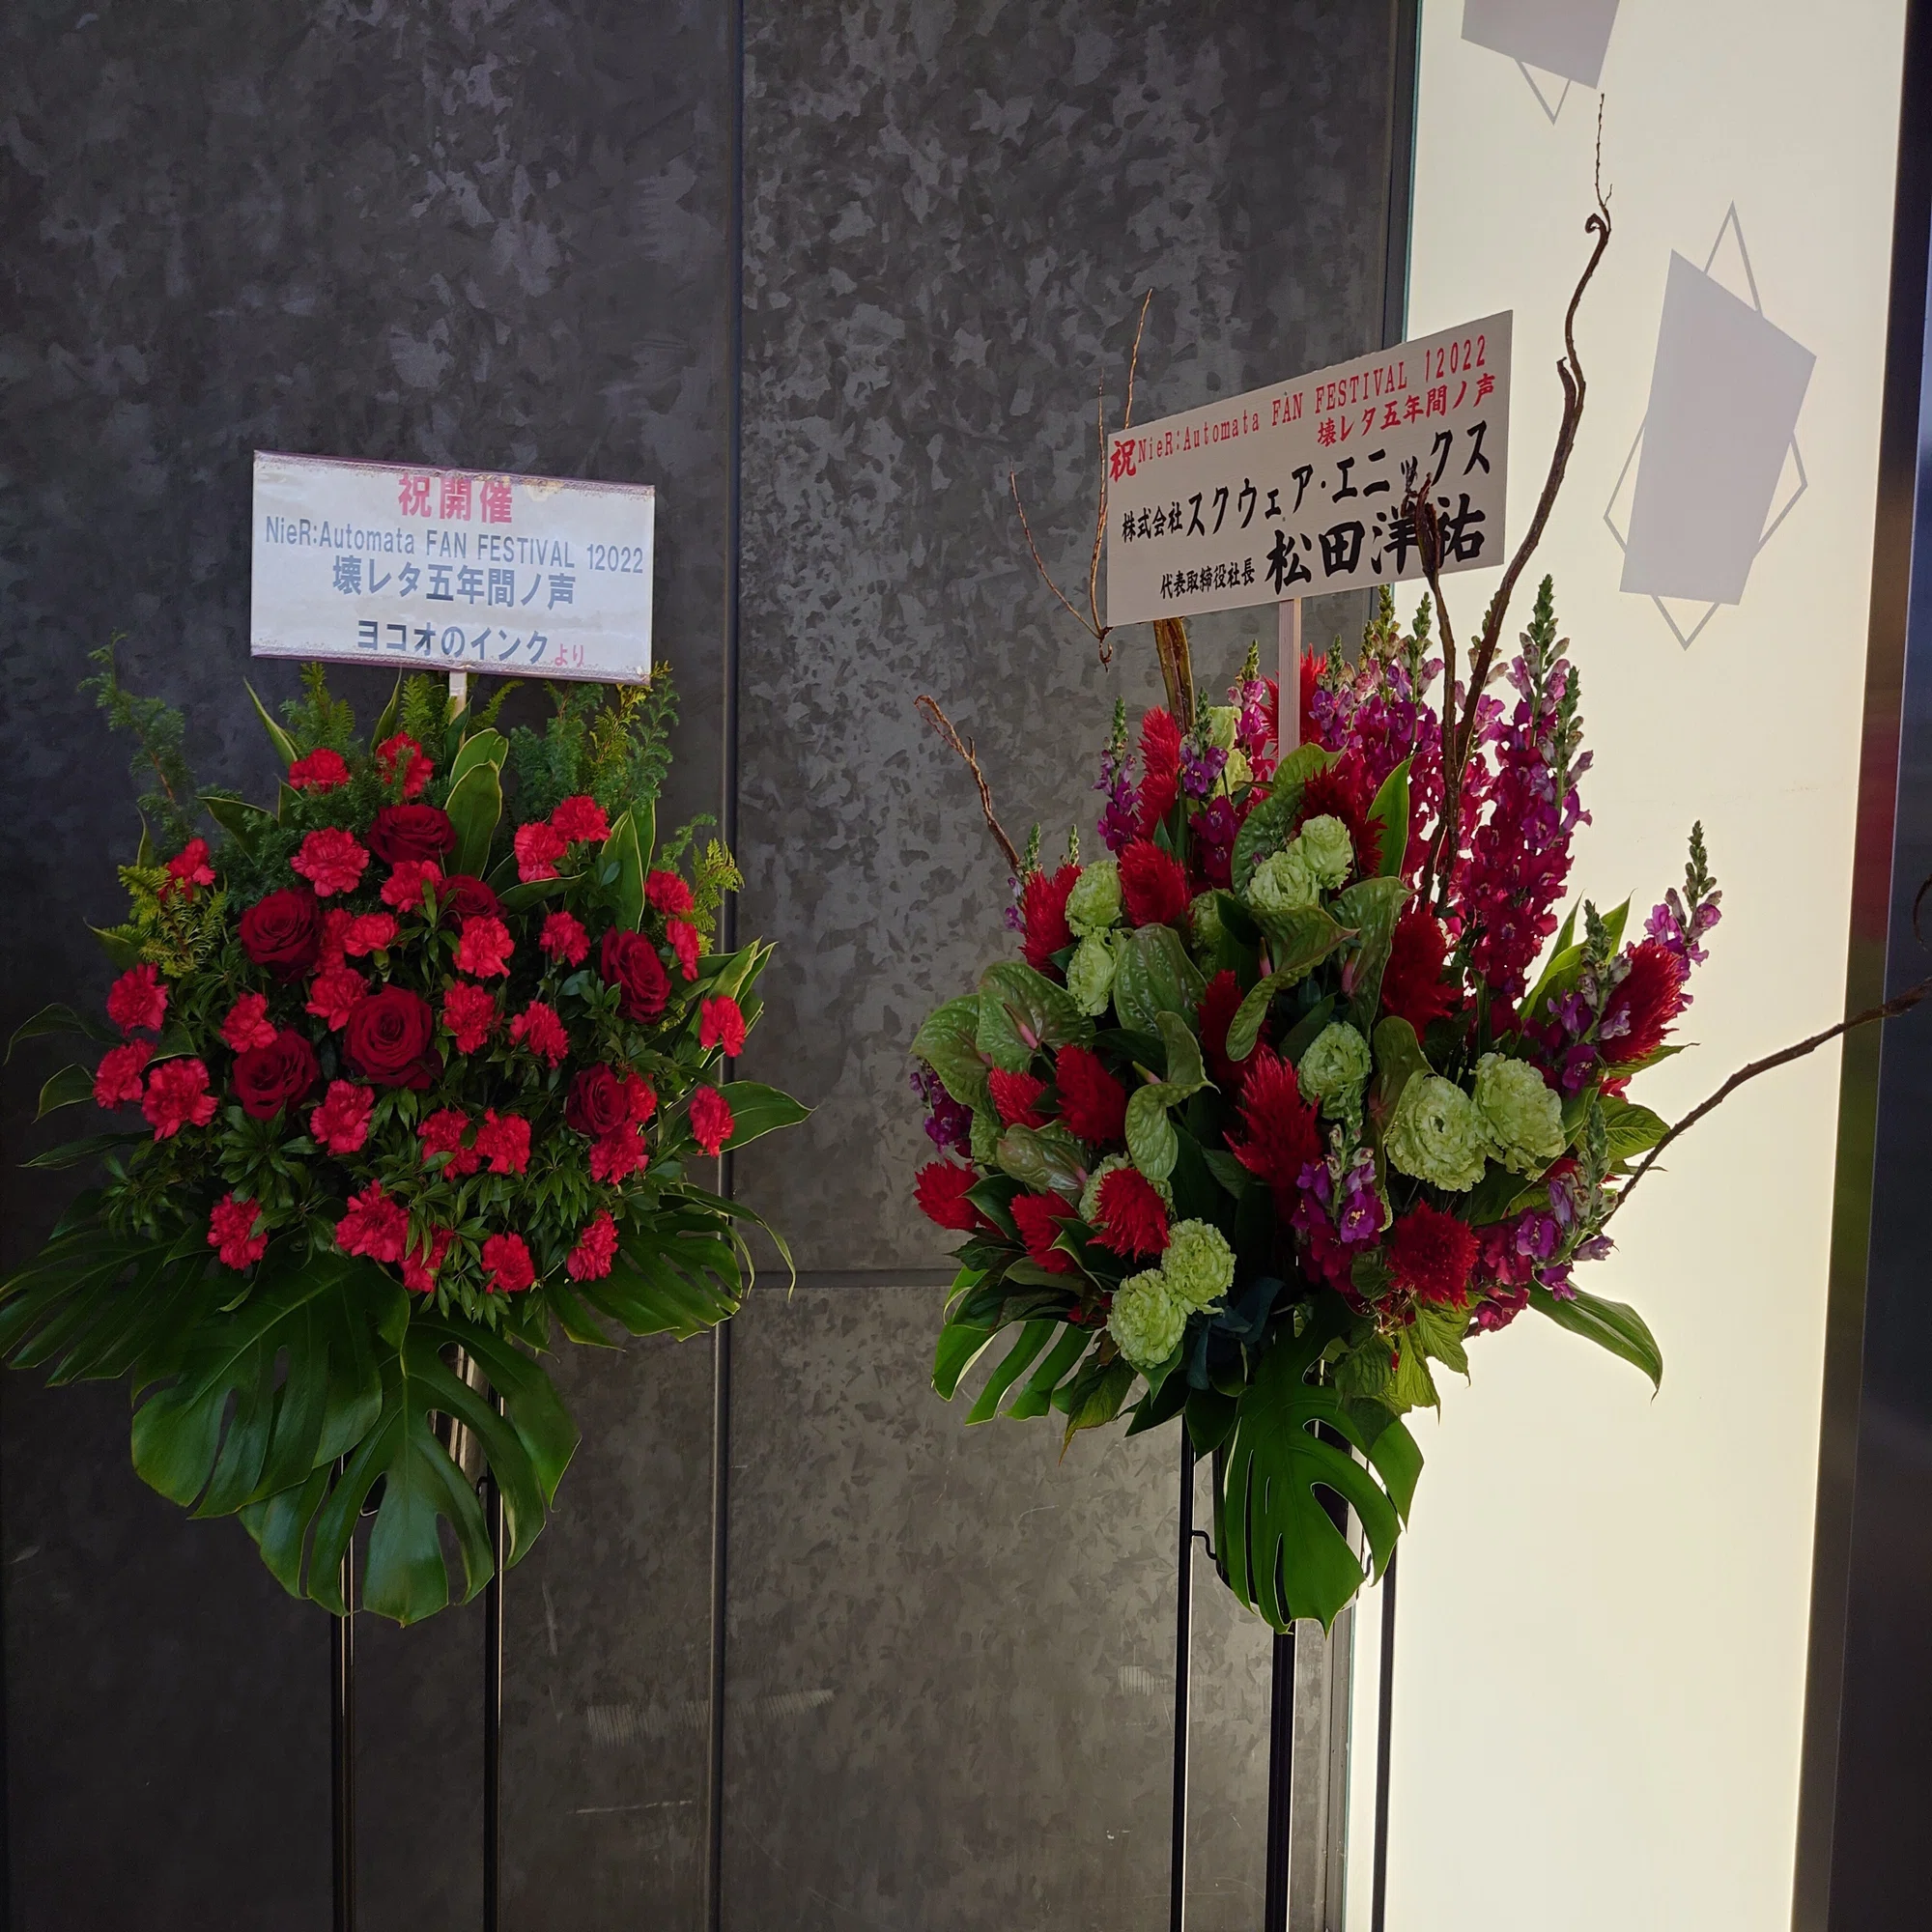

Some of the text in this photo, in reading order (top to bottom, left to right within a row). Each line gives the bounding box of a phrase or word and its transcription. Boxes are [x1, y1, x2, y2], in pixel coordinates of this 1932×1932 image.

[1109, 334, 1487, 482] 祝 NieR:Automata FAN FESTIVAL 12022
[1317, 373, 1496, 447] 壊レタ五年間ノ声
[397, 472, 513, 525] 祝開催
[265, 516, 644, 575] NieR:Automata FAN FESTIVAL 12022
[331, 554, 578, 611] 壊レタ五年間ノ声
[1160, 555, 1256, 600] 代表取締役社長
